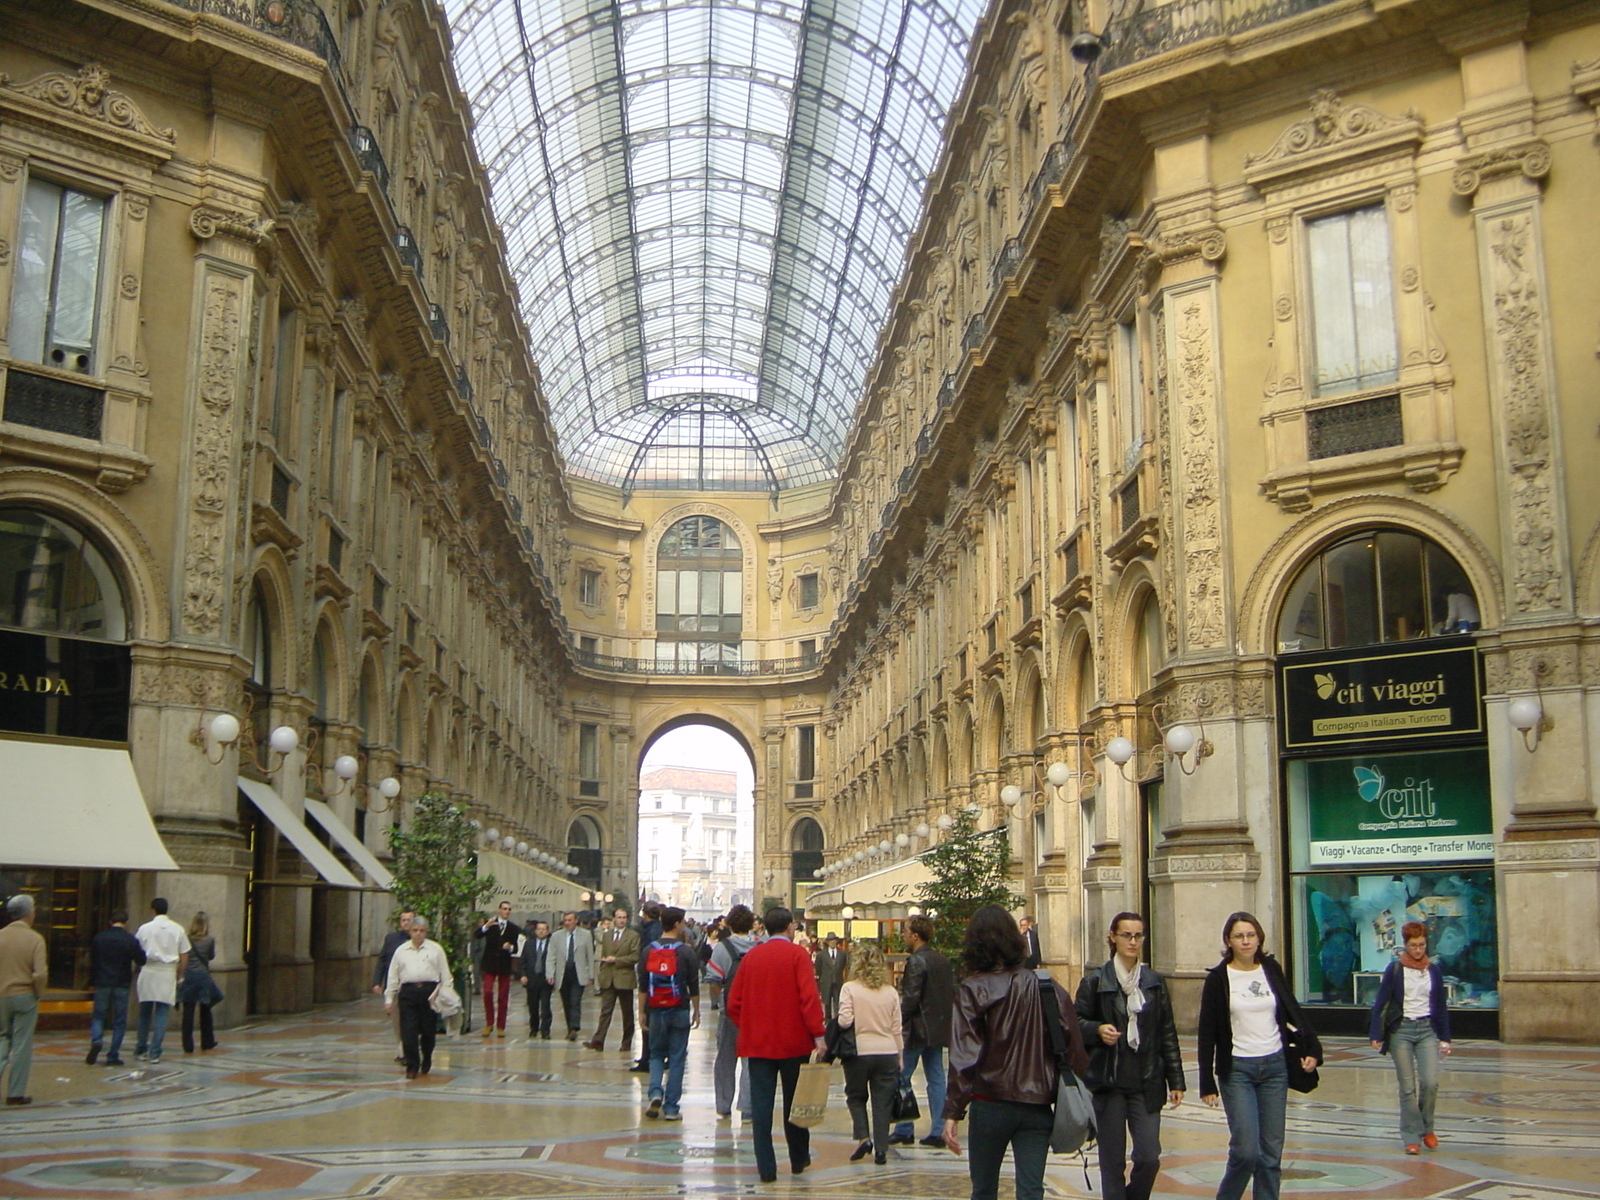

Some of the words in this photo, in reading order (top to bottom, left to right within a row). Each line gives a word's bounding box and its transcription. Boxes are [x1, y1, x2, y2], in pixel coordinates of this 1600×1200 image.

[1336, 682, 1364, 704] cit
[1372, 674, 1446, 706] viaggi
[1316, 720, 1369, 732] Compagnia
[1371, 716, 1406, 727] Italiana
[1408, 713, 1447, 724] Turismo
[1379, 777, 1435, 819] cit
[1358, 821, 1398, 831] Compagnia
[1399, 819, 1426, 829] Italiana
[1427, 818, 1457, 827] Turismo
[1320, 845, 1345, 858] Viaggi
[1351, 845, 1385, 856] Vacanze
[1391, 843, 1422, 856] Change
[1429, 841, 1464, 853] Transfer
[519, 884, 564, 896] Galleria
